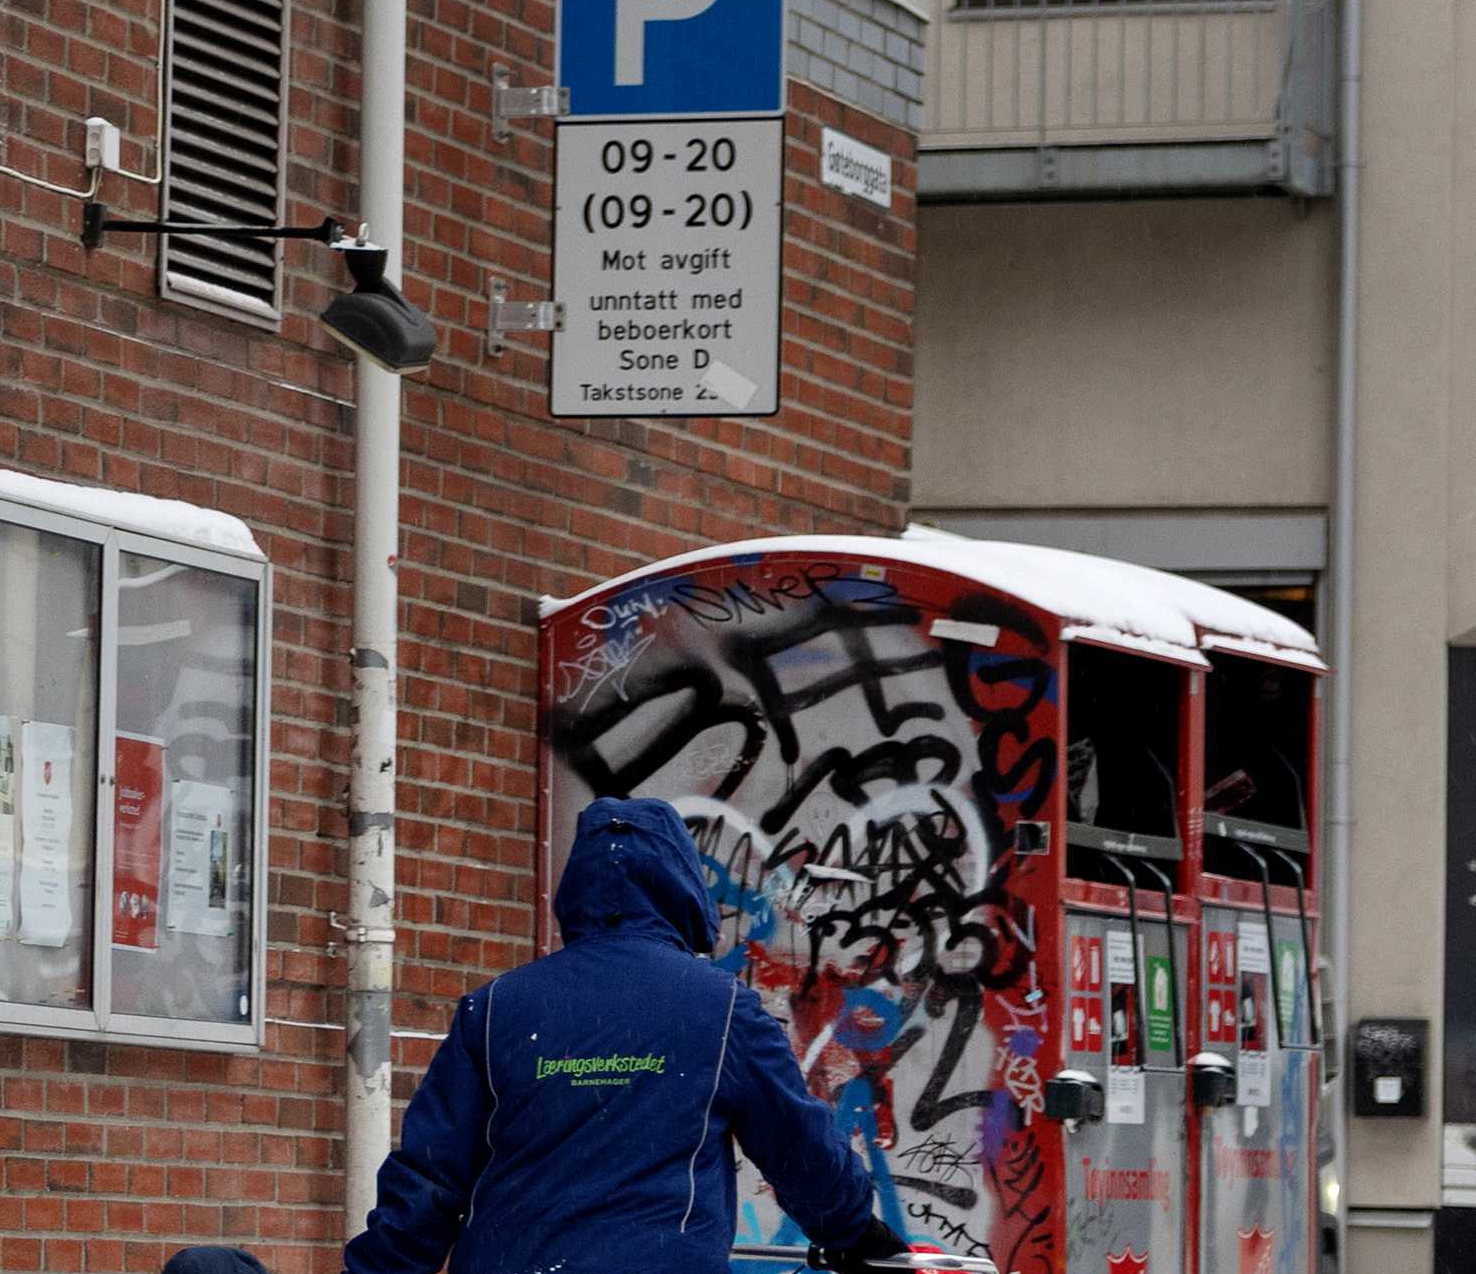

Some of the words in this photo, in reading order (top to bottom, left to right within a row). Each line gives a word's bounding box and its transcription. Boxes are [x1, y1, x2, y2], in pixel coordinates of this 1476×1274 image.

[602, 250, 647, 272] Mot
[662, 248, 731, 274] avgift
[590, 292, 677, 312] unntatt
[692, 290, 742, 310] med
[599, 320, 733, 341] beboerkort
[620, 351, 679, 371] Sone
[694, 349, 710, 369] D
[581, 383, 684, 402] Takstsone
